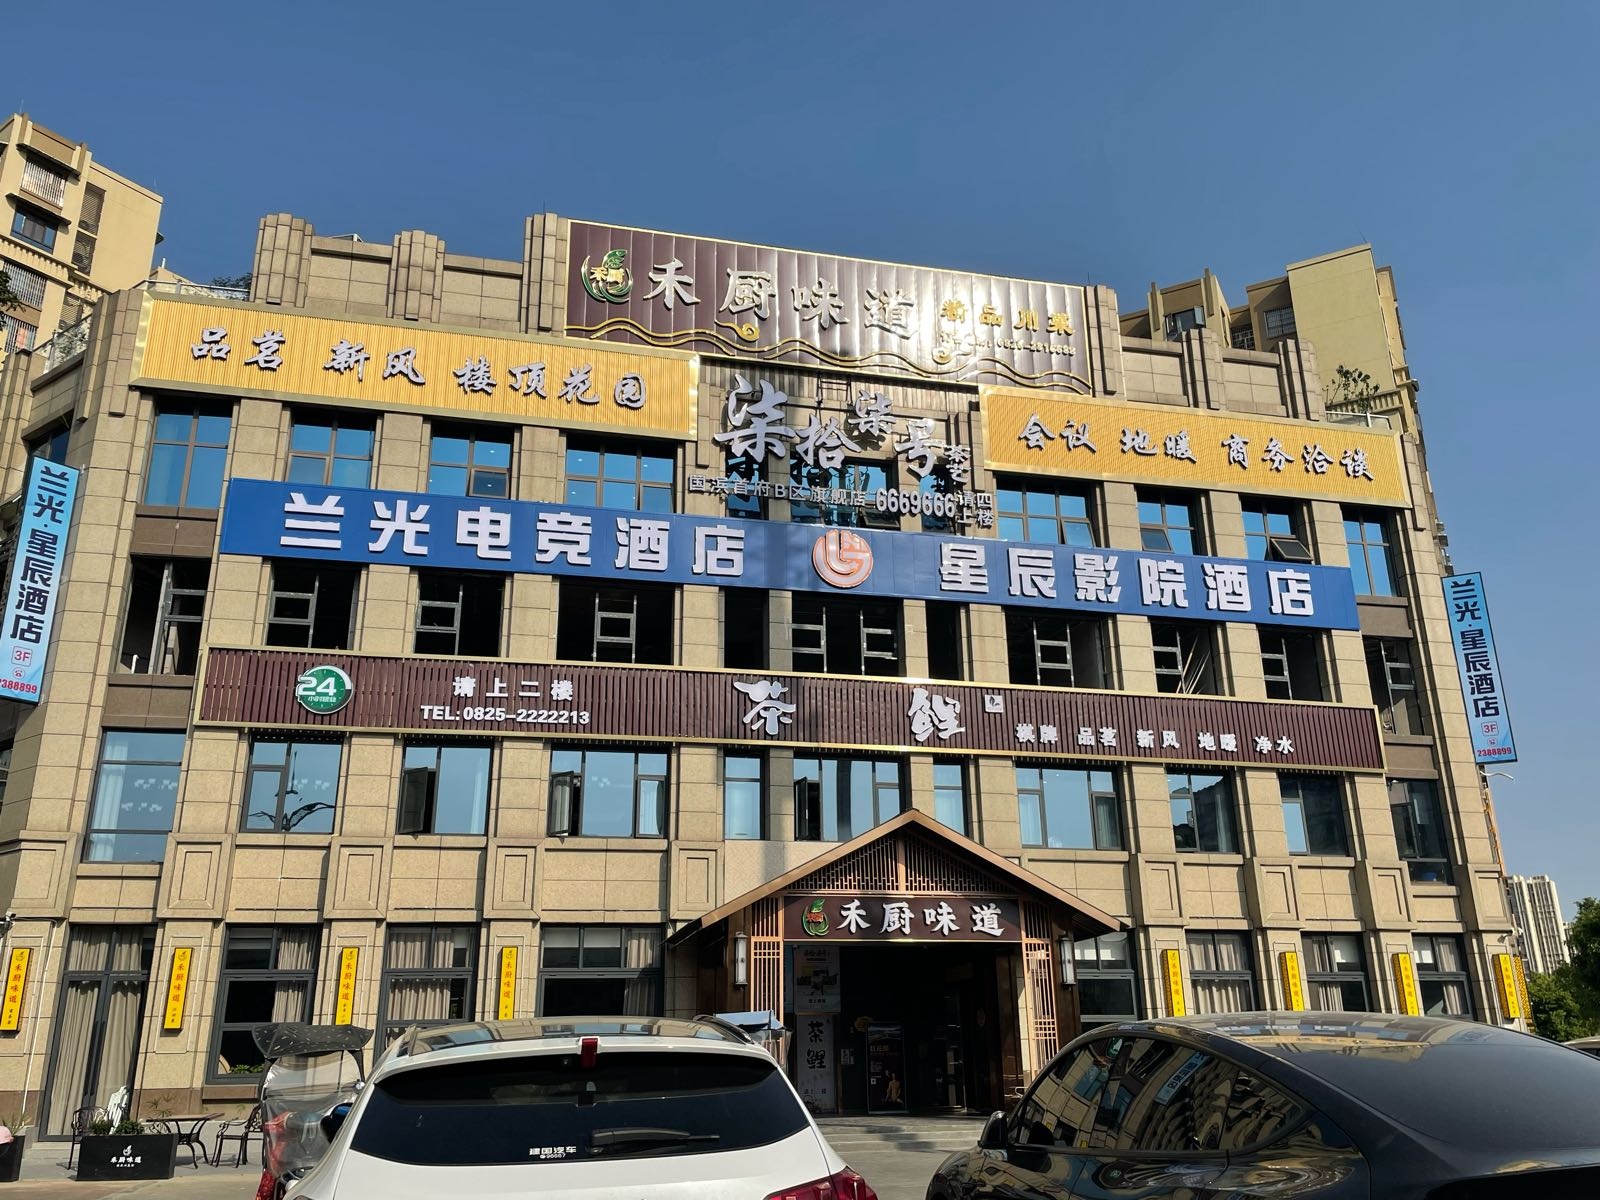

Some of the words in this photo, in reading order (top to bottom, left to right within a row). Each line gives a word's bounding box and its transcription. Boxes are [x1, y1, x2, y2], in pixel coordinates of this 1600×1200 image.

[643, 257, 919, 341] 禾厨味道
[191, 326, 286, 371] 品茗
[323, 339, 426, 387] 新风
[453, 356, 648, 410] 楼顶花园
[714, 373, 944, 478] 柒拾柒号
[944, 444, 971, 484] 茶艺
[1018, 413, 1097, 452] 会议
[1120, 428, 1197, 463] 地暖
[1221, 433, 1375, 480] 商务洽谈
[876, 488, 957, 518] 6669666
[280, 492, 746, 577] 兰光电竞酒店
[939, 541, 1315, 616] 星辰影院酒店
[14, 650, 30, 661] 3F
[298, 676, 337, 696] 24
[453, 676, 573, 702] 请上二楼
[1016, 724, 1058, 744] 棋牌
[1077, 727, 1117, 747] 品茗
[1137, 729, 1180, 748] 新风
[1254, 735, 1294, 754] 净水
[1483, 724, 1496, 733] 3F
[836, 899, 1005, 937] 禾厨味道
